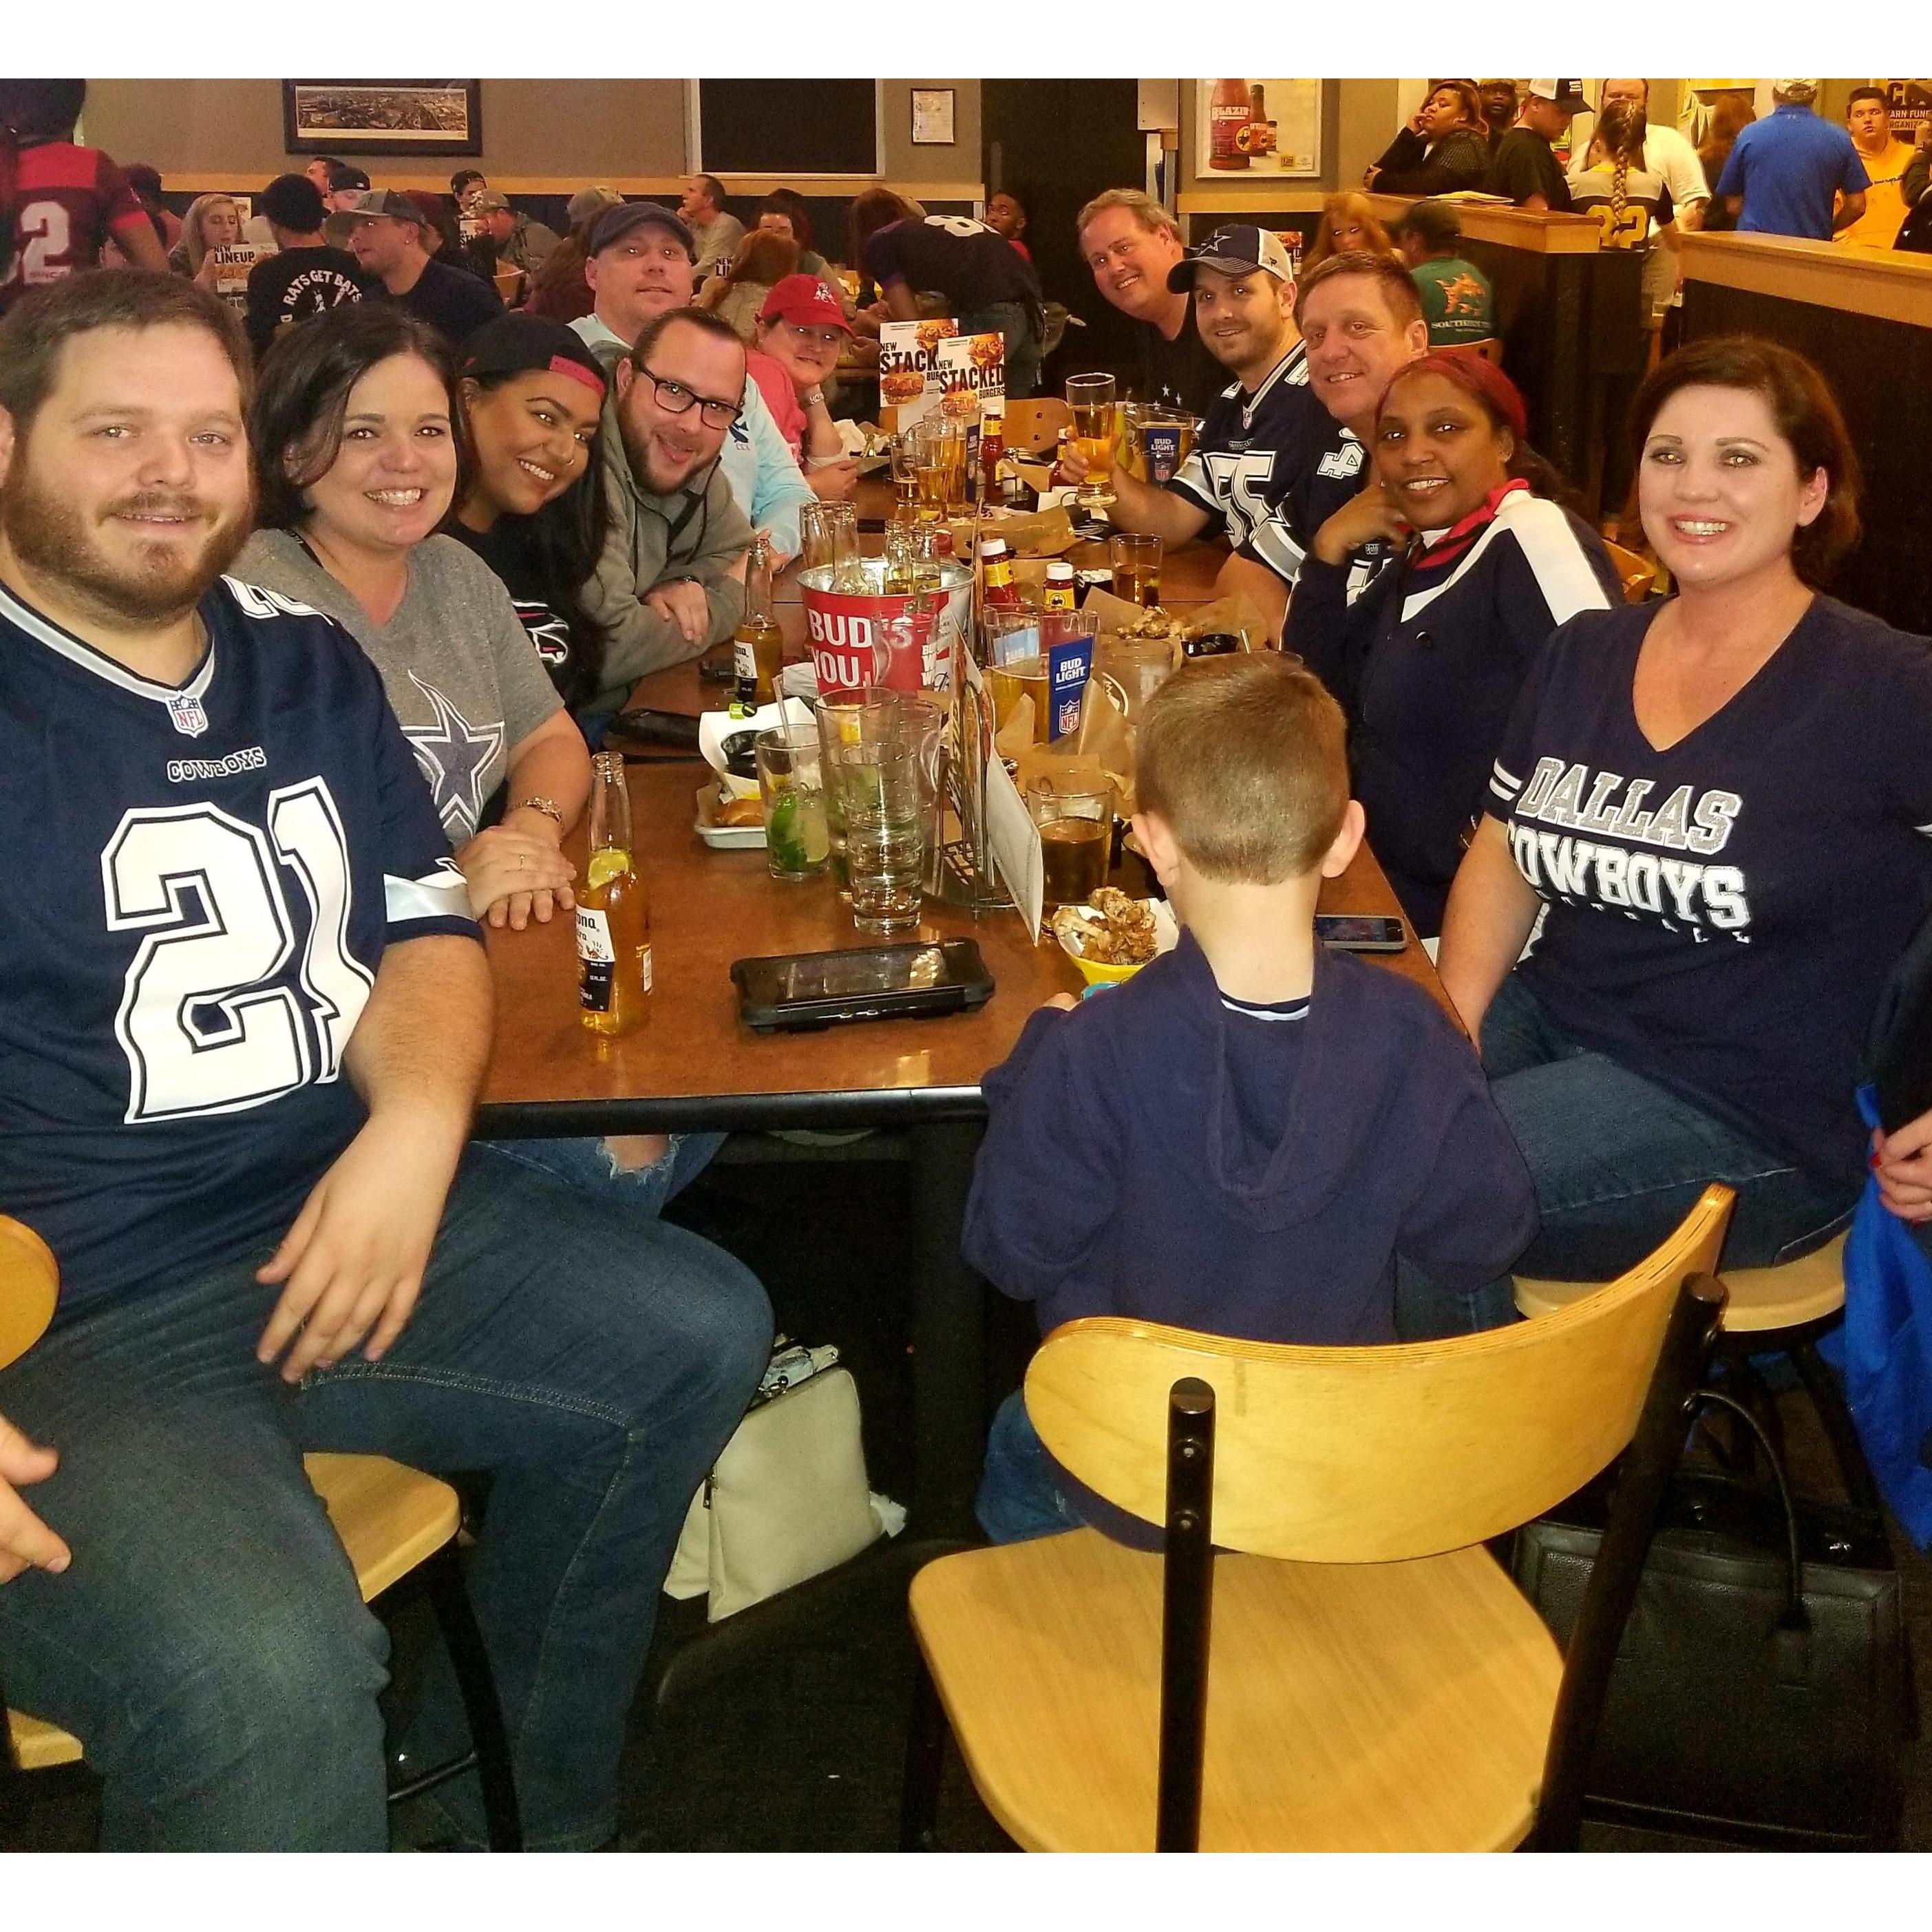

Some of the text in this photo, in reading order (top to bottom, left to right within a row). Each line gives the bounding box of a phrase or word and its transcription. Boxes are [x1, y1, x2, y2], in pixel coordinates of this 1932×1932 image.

[1889, 109, 1907, 118] ARN
[21, 200, 72, 286] 2
[215, 251, 255, 264] LINEUP
[283, 274, 312, 306] RATS
[309, 269, 334, 284] GET
[333, 273, 363, 304] BATS
[880, 341, 898, 352] NEW
[880, 347, 938, 376] STACK
[939, 359, 953, 370] NEW
[939, 363, 1004, 394] STACKED
[979, 386, 1006, 400] BURGERS
[1060, 657, 1083, 672] BUD
[1056, 666, 1087, 683] LIGHT
[176, 710, 203, 729] NFL
[1061, 712, 1078, 729] NFL
[167, 746, 268, 783] COWBOYS
[1515, 756, 1743, 856] DALLAS
[1507, 818, 1751, 930] OWBOYS
[100, 775, 376, 1125] 21
